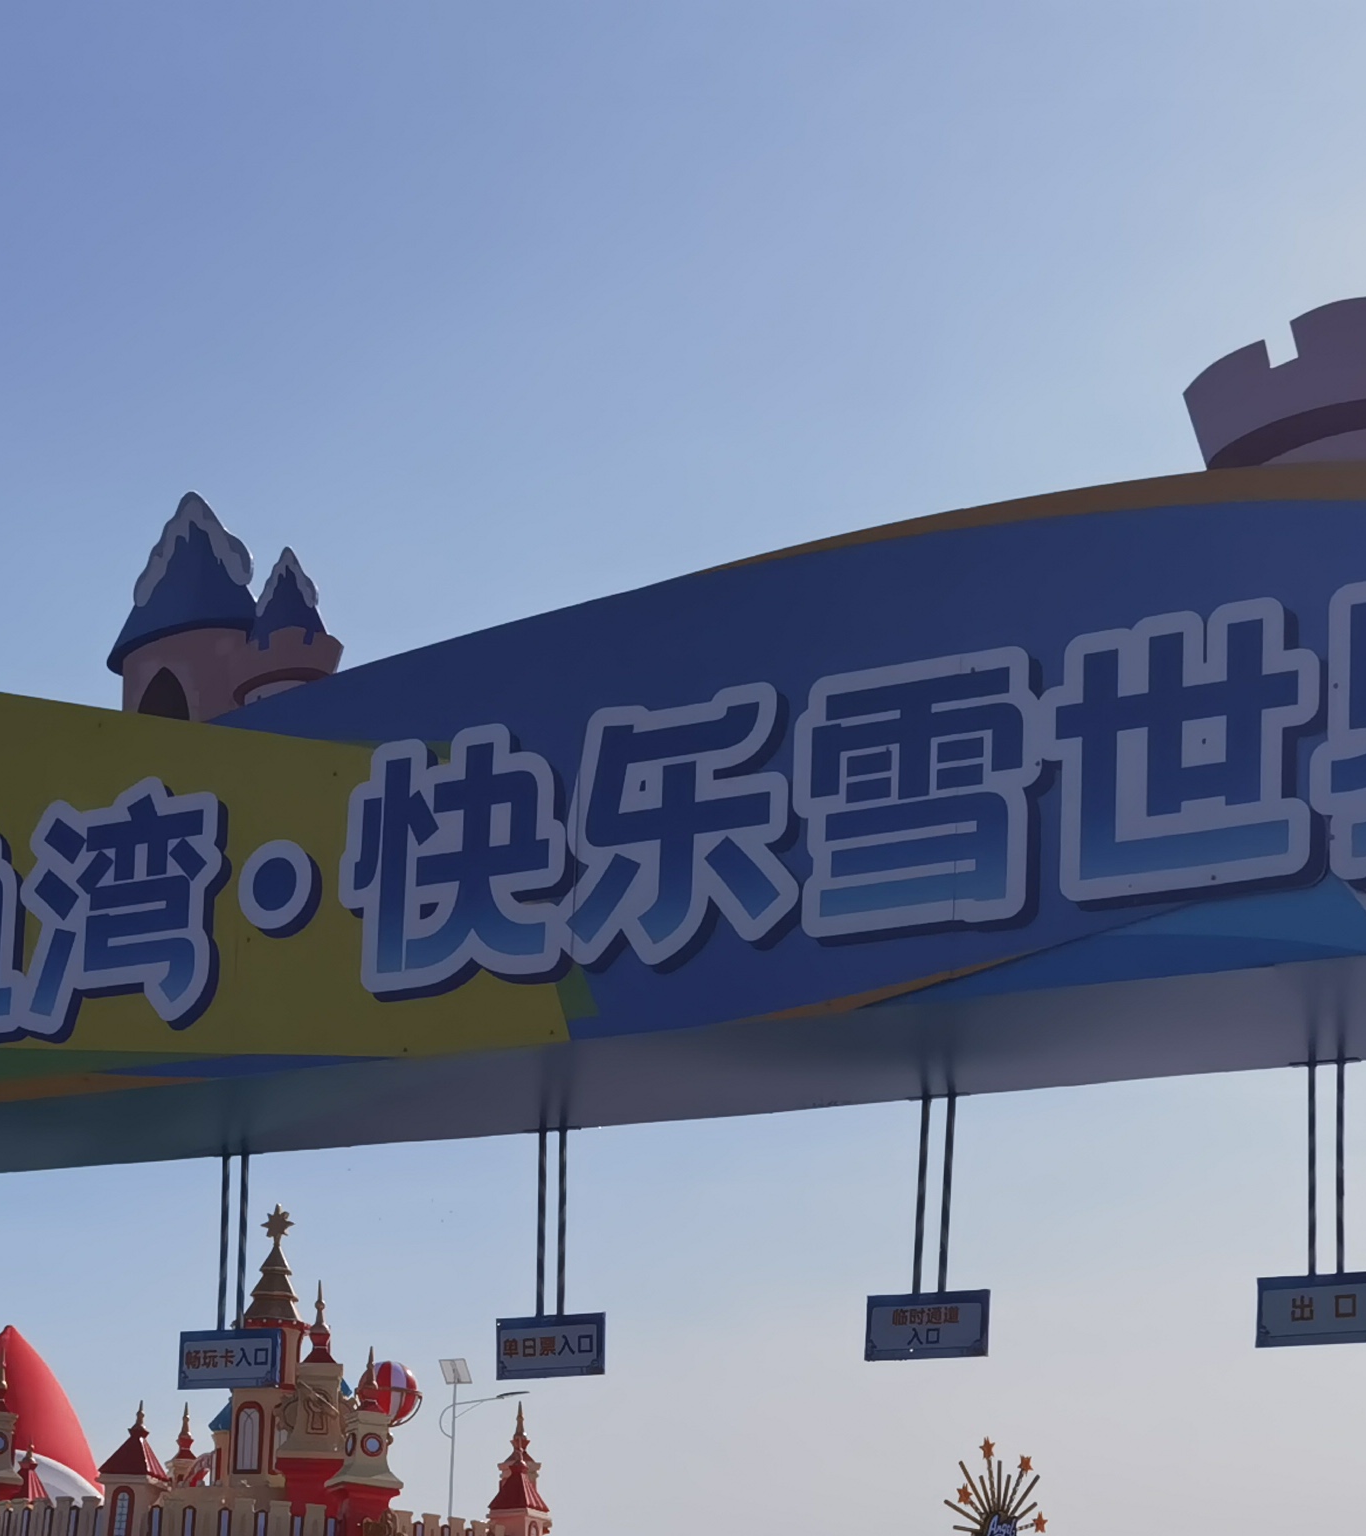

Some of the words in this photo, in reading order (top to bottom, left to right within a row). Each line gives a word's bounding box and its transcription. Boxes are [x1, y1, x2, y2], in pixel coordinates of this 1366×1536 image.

[1290, 1293, 1357, 1322] 出口
[502, 1333, 595, 1359] 单日票入口
[907, 1328, 941, 1346] 入口
[184, 1347, 270, 1371] 畅玩卡入口
